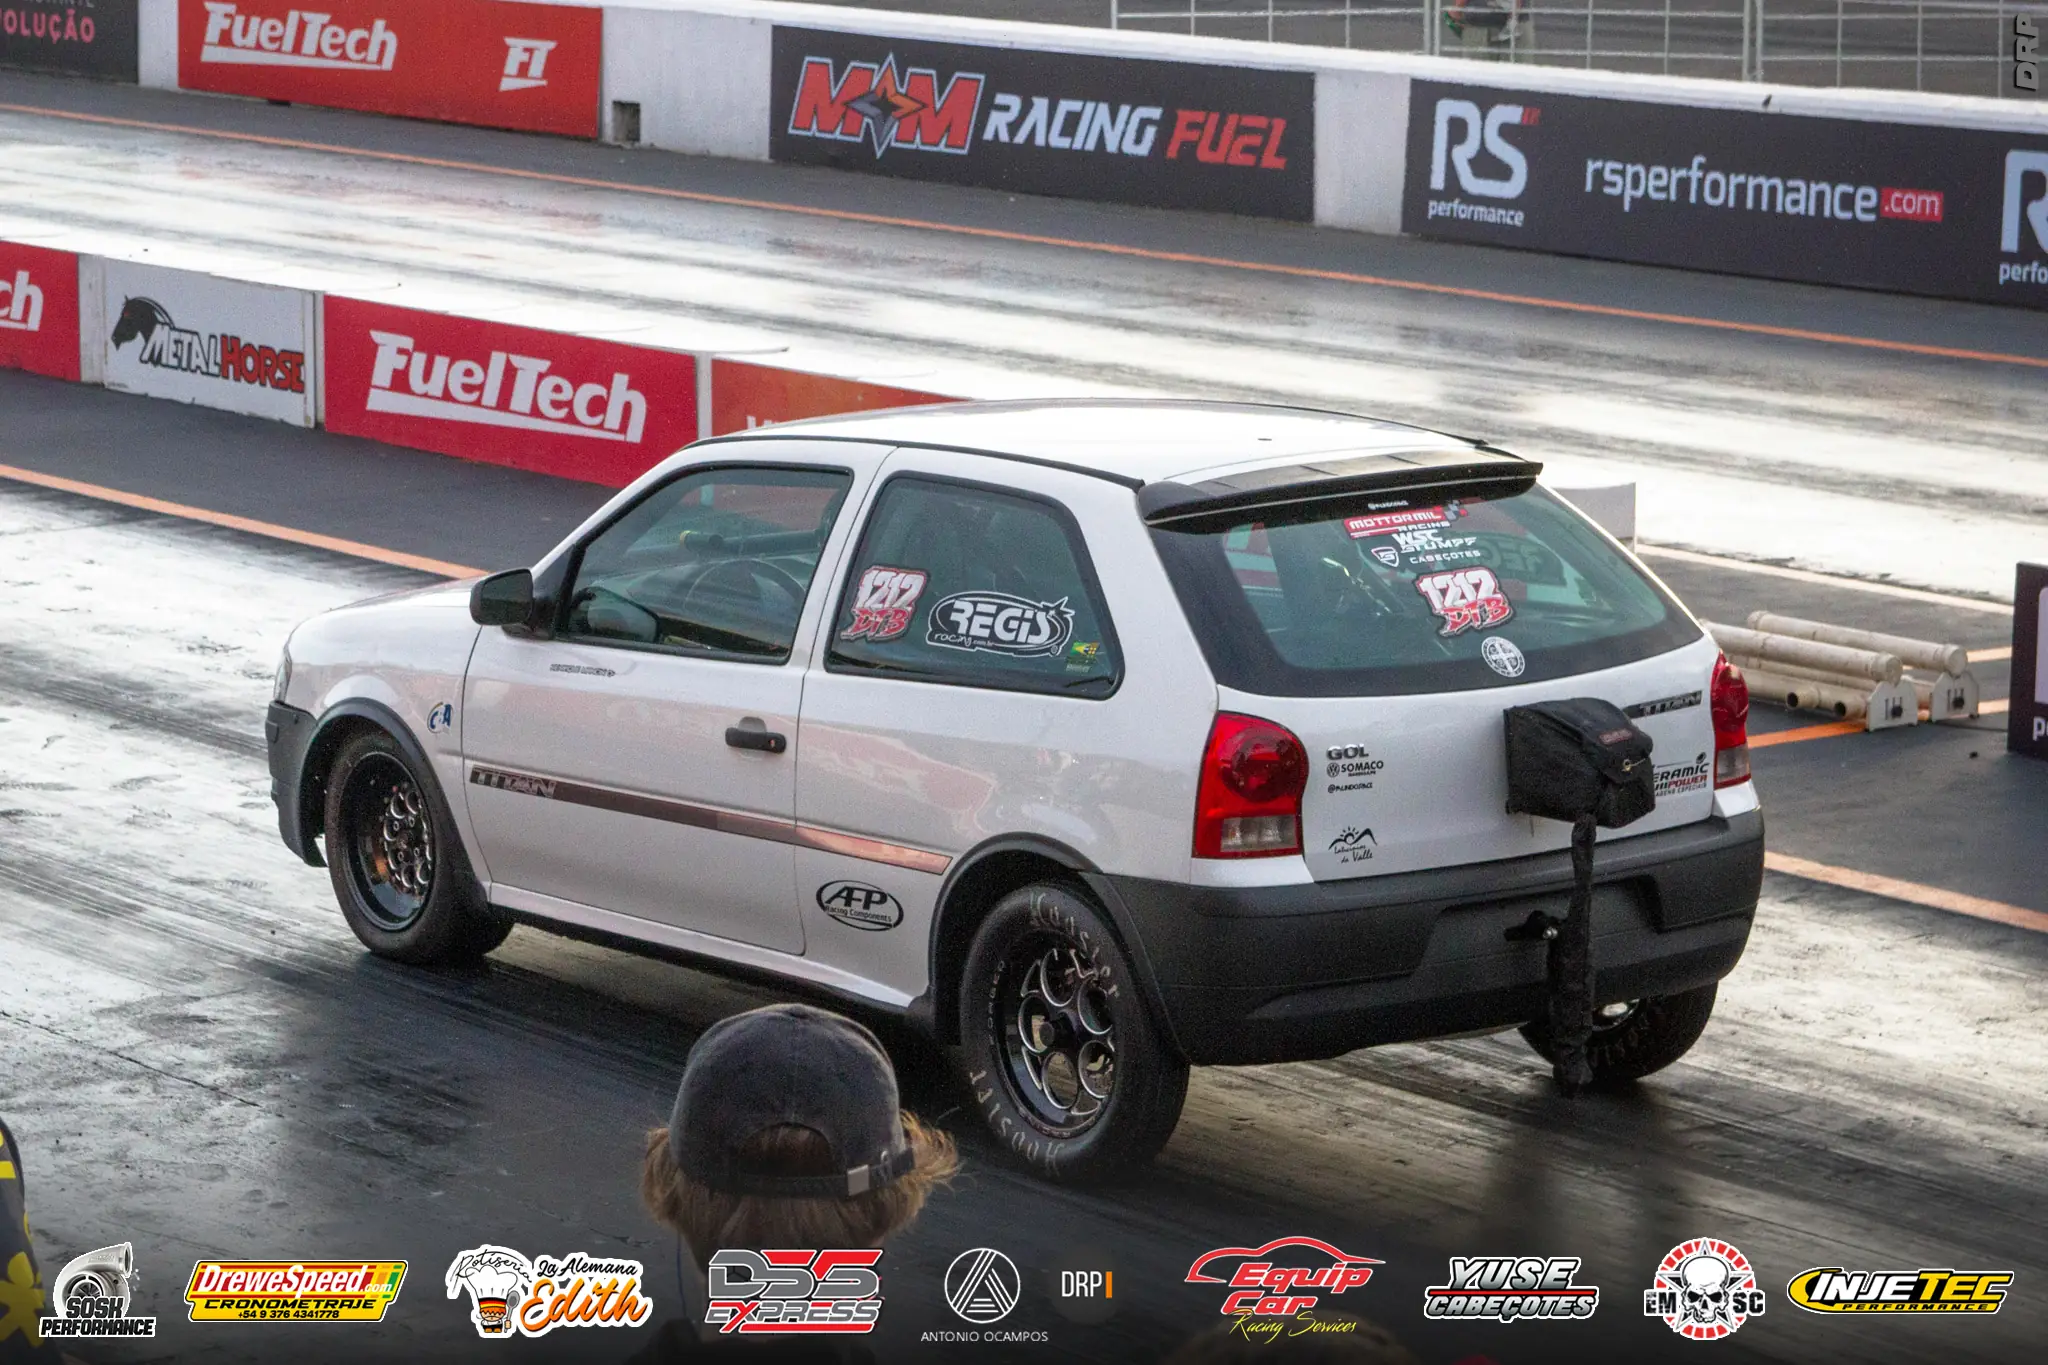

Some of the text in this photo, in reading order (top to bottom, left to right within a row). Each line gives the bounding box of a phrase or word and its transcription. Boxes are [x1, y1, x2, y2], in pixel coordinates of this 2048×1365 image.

[0, 8, 95, 44] OLUÇÃO
[201, 3, 397, 71] FuelTech
[500, 36, 558, 91] FT
[983, 93, 1162, 155] RACING
[1166, 109, 1287, 170] FUEL
[1430, 98, 1528, 199] RS
[1427, 198, 1525, 227] performance
[366, 330, 647, 443] FuelTech
[1349, 511, 1441, 530] MOTTORMIL
[1398, 521, 1450, 532] RACING
[1391, 529, 1443, 546] WSC
[1400, 536, 1477, 553] STUMPF
[1409, 549, 1481, 564] CABEÇOTES
[855, 569, 924, 610] 1212
[1419, 569, 1502, 612] 1212
[934, 632, 973, 647] racing
[1327, 744, 1369, 760] GOL
[1341, 760, 1384, 773] SOMACO
[473, 767, 557, 798] TITAN
[1654, 763, 1709, 783] ERAMIC
